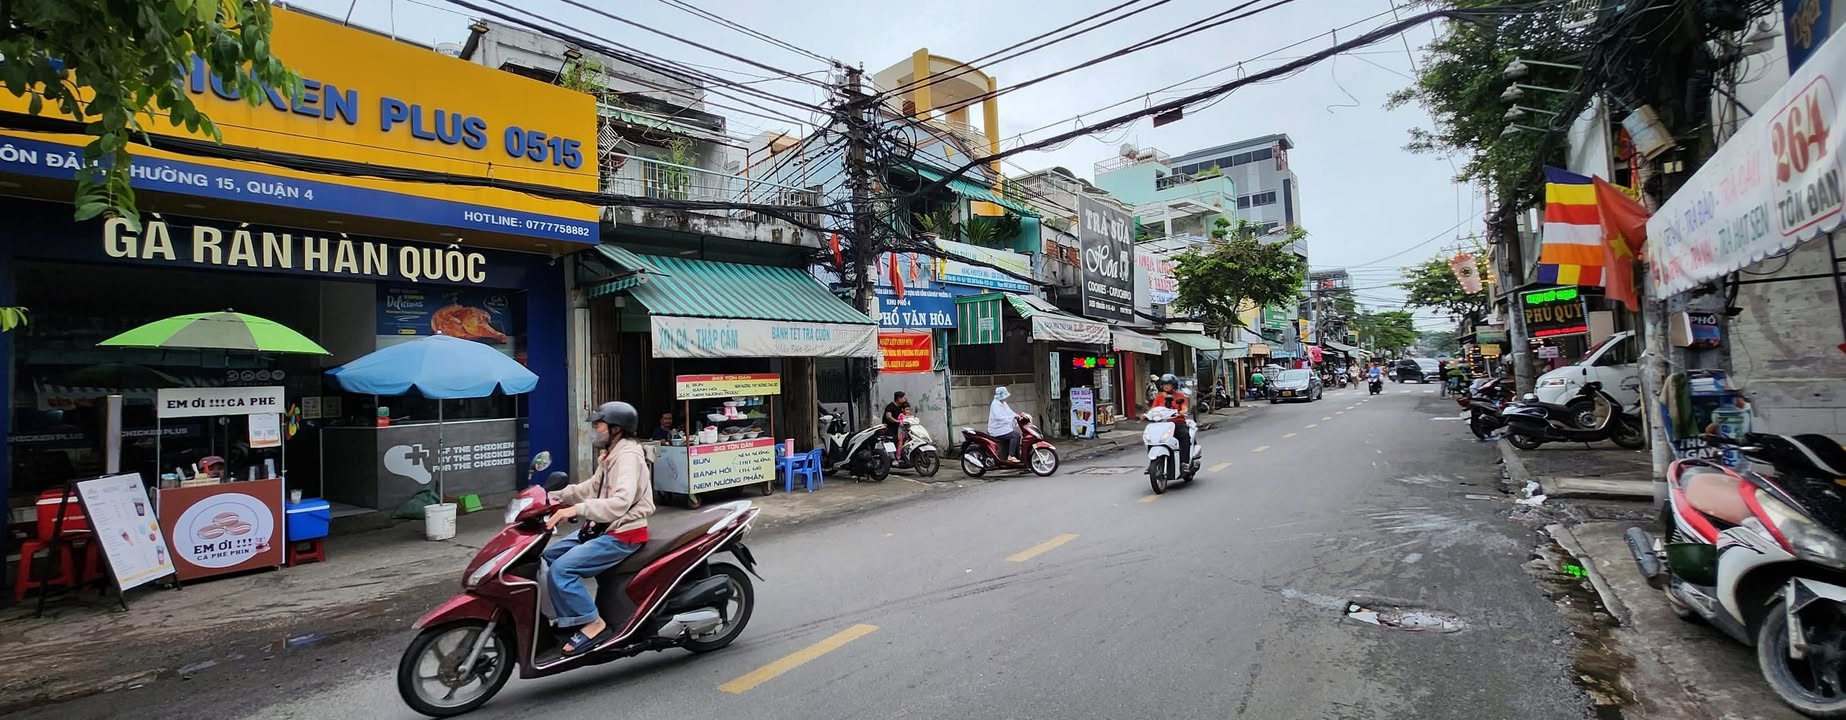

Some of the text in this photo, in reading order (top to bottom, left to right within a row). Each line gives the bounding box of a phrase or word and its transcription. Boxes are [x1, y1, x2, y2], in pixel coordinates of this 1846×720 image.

[380, 96, 488, 150] PLUS
[505, 126, 583, 170] 0515
[1772, 87, 1830, 186] 264
[215, 177, 241, 193] 15,
[247, 180, 300, 200] QUẬN
[304, 189, 314, 200] 4
[464, 210, 590, 237] HOTLINE: 0777758882
[1085, 208, 1109, 237] TRÀ
[103, 212, 487, 284] GÀ RÁN HÀN QUỐC
[1088, 280, 1107, 295] COOKIES
[902, 308, 927, 326] VĂN
[929, 310, 953, 326] HÓA
[167, 399, 188, 409] EM
[453, 446, 471, 454] THE
[474, 442, 514, 452] CHICKEN
[474, 450, 514, 460] CHICKEN
[453, 462, 471, 470] THE
[474, 457, 514, 468] CHICKEN
[193, 543, 215, 555] EM
